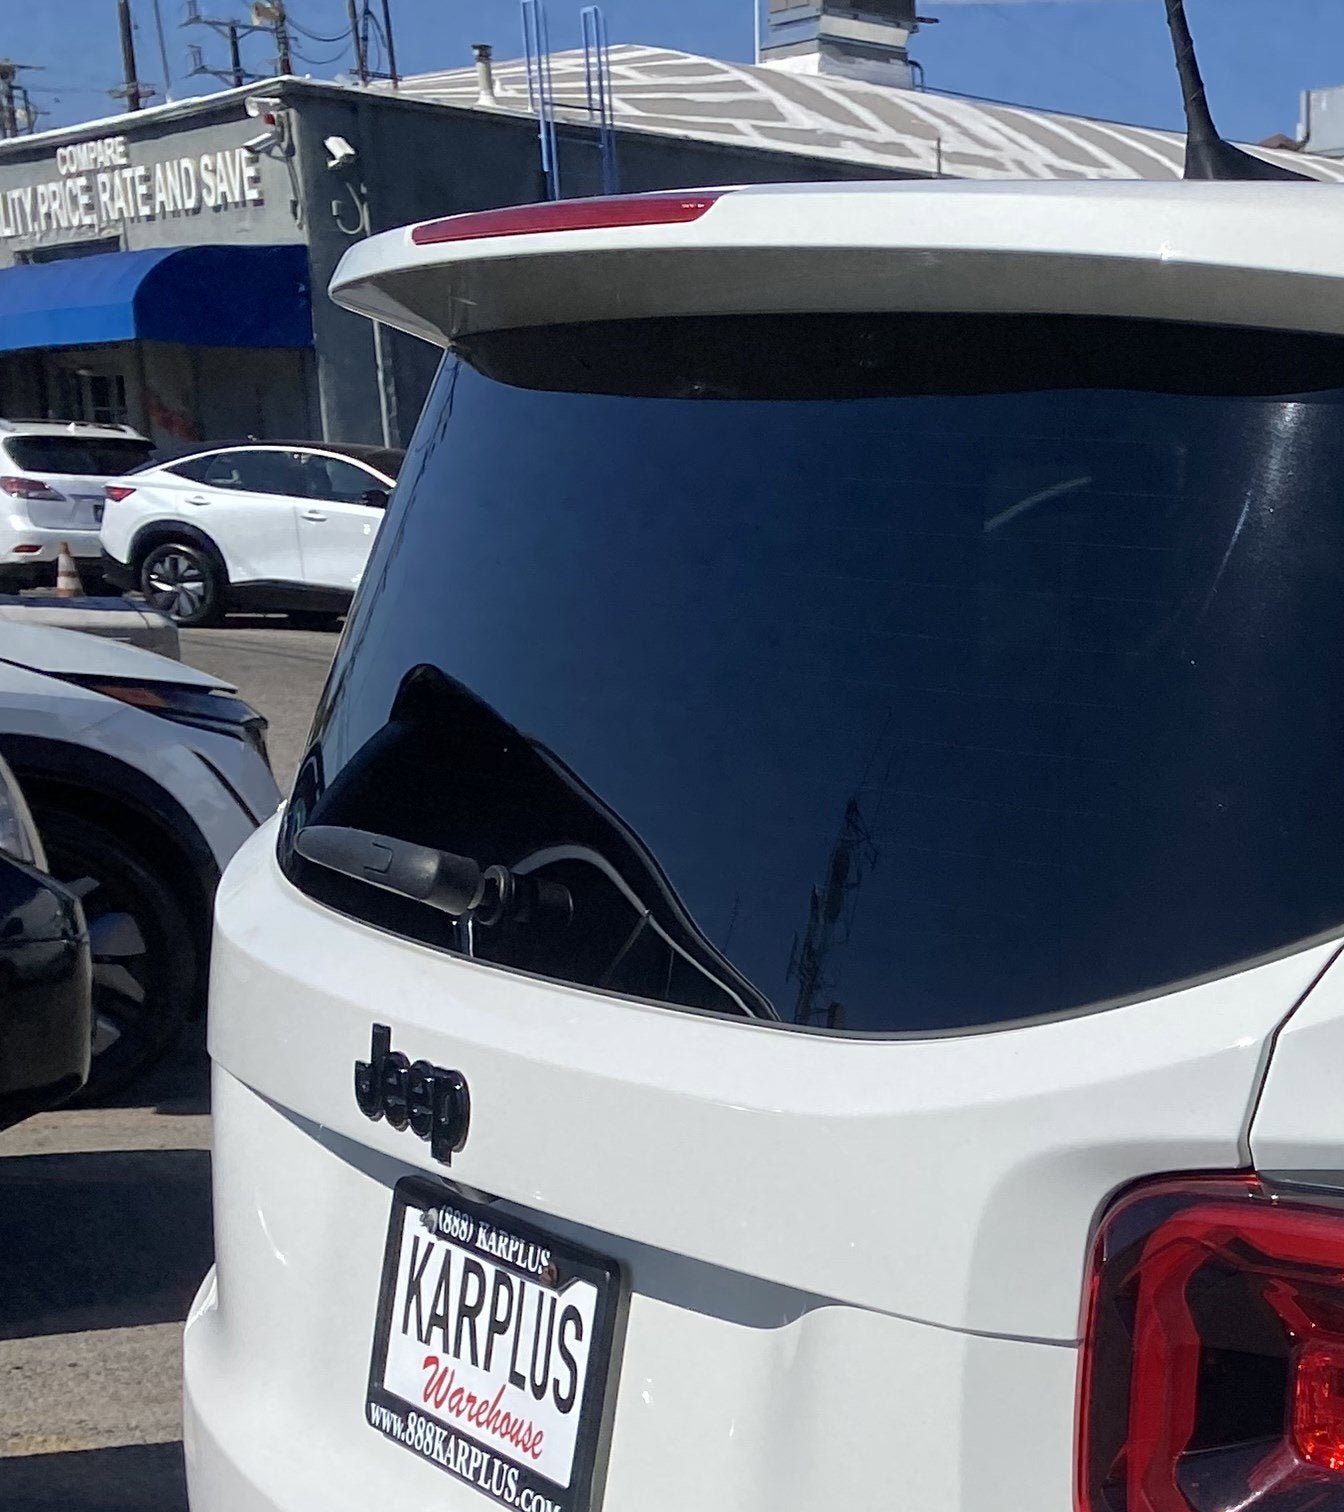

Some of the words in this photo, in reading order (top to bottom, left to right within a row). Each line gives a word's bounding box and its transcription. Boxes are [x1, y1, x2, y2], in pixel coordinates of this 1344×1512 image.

[57, 136, 127, 175] COMPARE
[97, 166, 151, 222] RATE
[155, 157, 197, 214] AND
[201, 147, 259, 208] SAVE
[354, 1022, 471, 1168] Jeep
[438, 1203, 474, 1243] (888)
[475, 1219, 551, 1275] KARPLUS
[401, 1234, 583, 1415] KARPLUS
[422, 1355, 544, 1459] Warehouse
